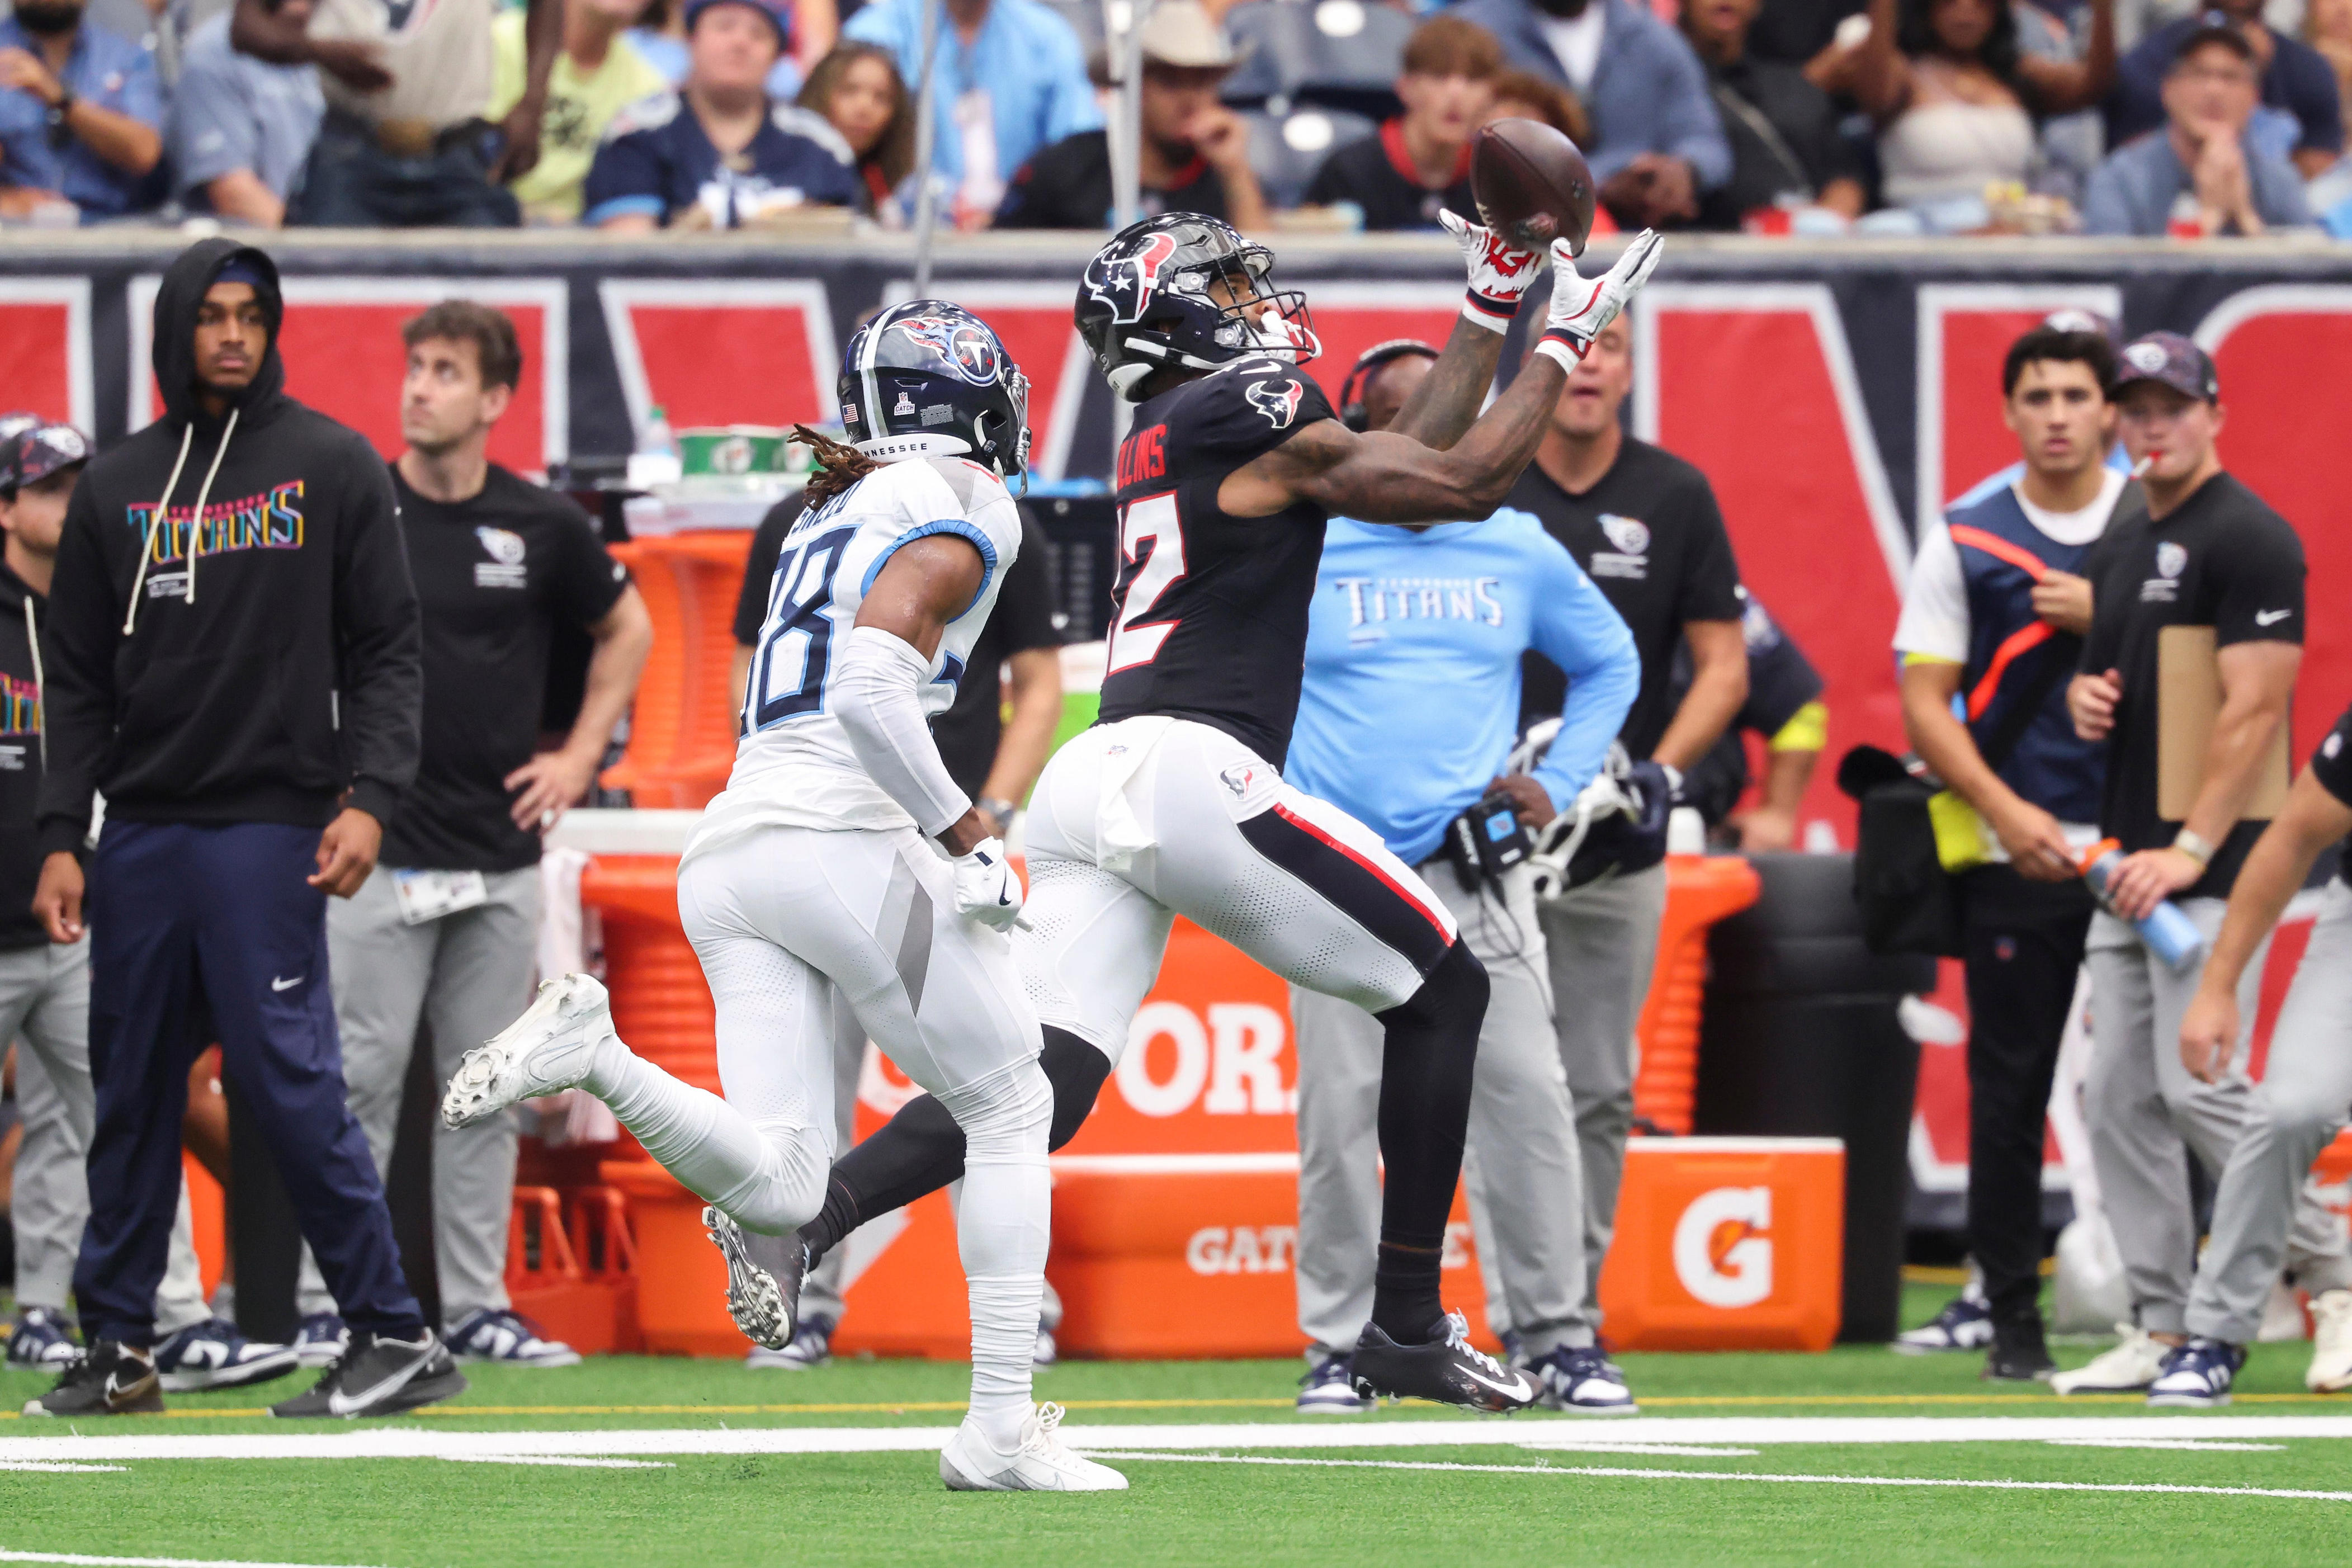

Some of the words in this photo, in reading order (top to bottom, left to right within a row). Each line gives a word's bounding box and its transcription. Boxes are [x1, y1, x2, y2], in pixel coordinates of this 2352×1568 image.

[863, 443, 927, 458] NNESSEE
[1117, 423, 1167, 492] LLINS
[1335, 577, 1503, 627] TITANS
[1673, 1186, 1773, 1307] G
